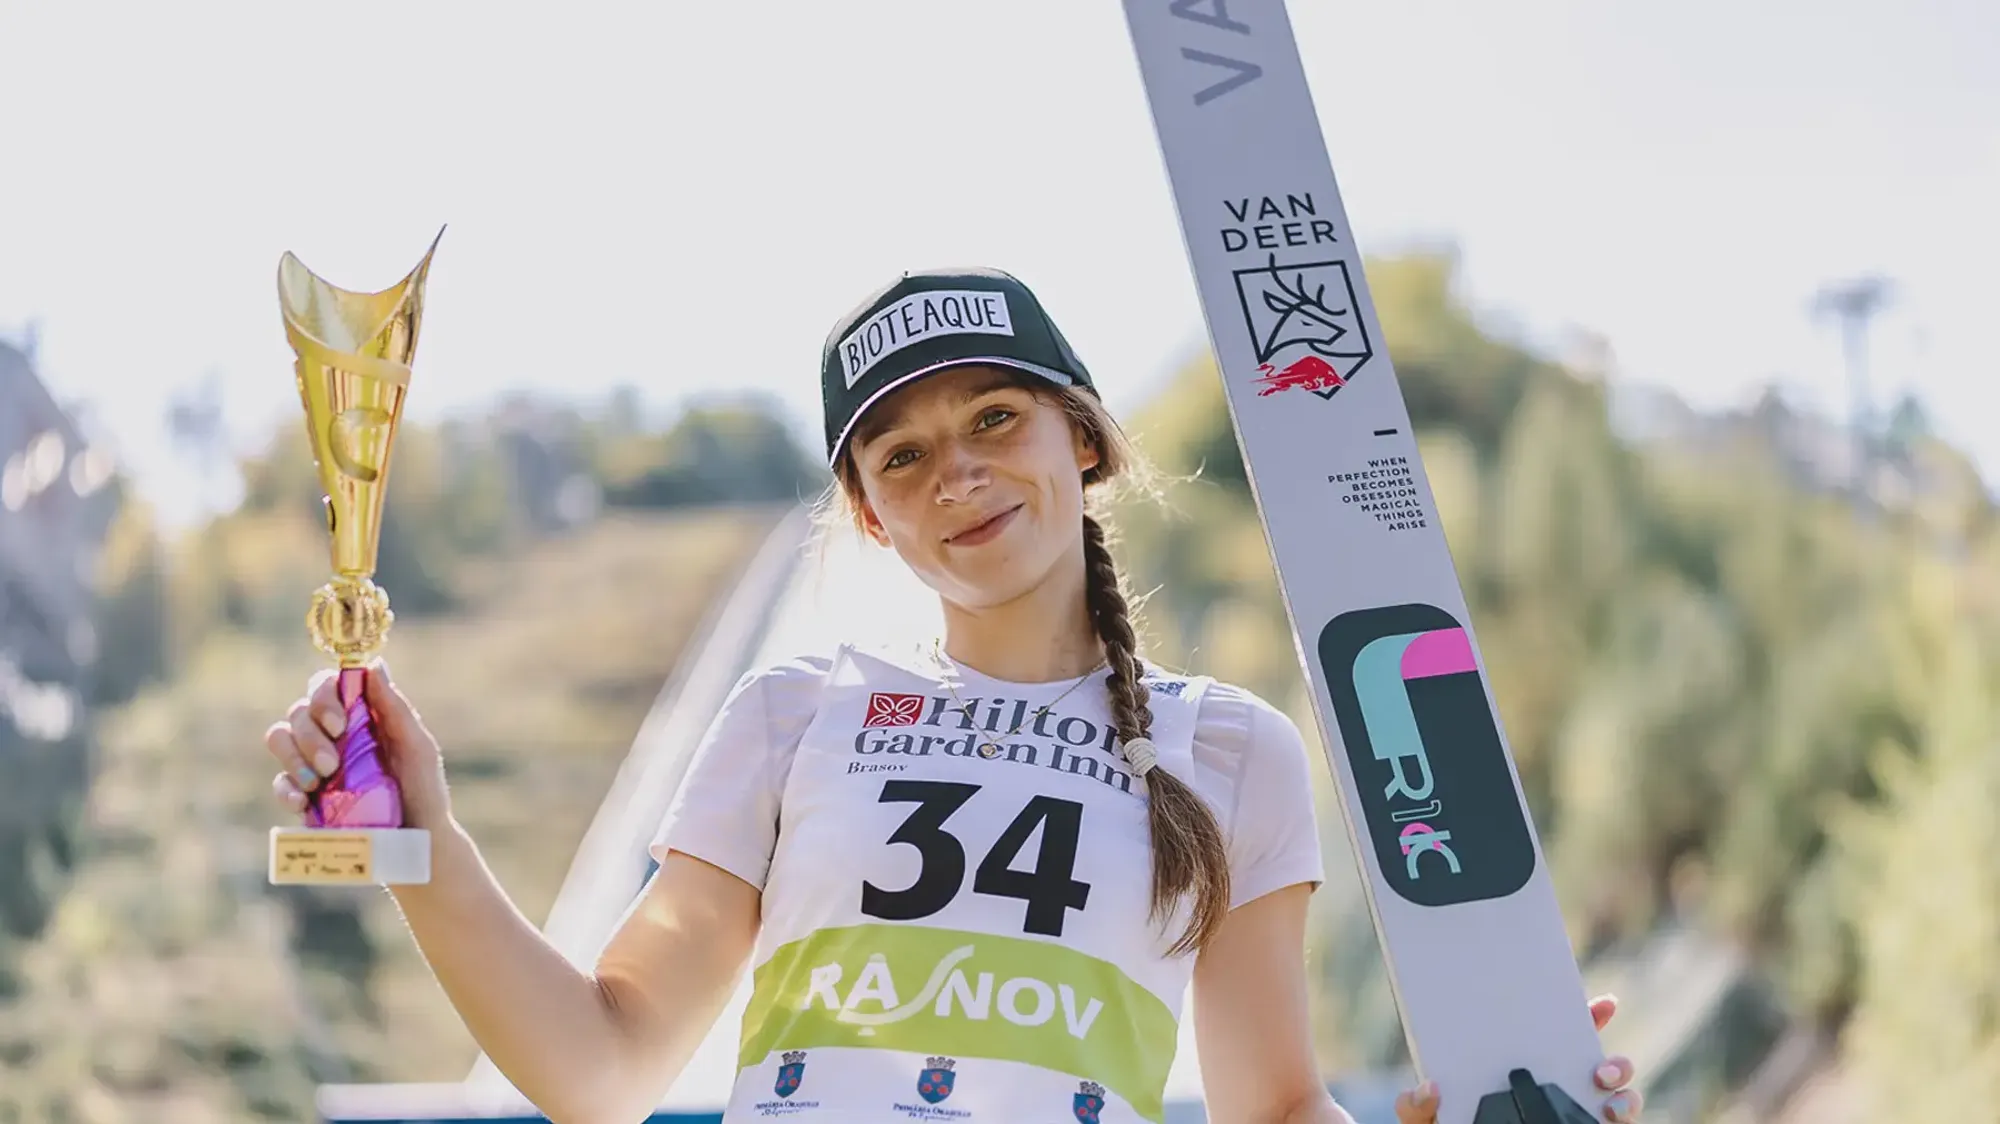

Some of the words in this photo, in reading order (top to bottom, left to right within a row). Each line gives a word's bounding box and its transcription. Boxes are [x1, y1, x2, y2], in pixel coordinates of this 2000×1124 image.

[1223, 192, 1316, 223] VAN
[1220, 219, 1338, 252] DEER
[846, 296, 1006, 377] BIOTEAQUE
[1367, 456, 1407, 468] WHEN
[1327, 467, 1410, 483] PERFECTION
[1351, 477, 1414, 492] BECOMES
[1341, 488, 1417, 504] OBSESSION
[1360, 499, 1420, 512] MAGICAL
[1374, 510, 1423, 522] THINGS
[1388, 519, 1427, 531] ARISE
[854, 727, 1039, 767] Garden
[846, 761, 908, 775] Brasov
[861, 779, 1091, 937] 34
